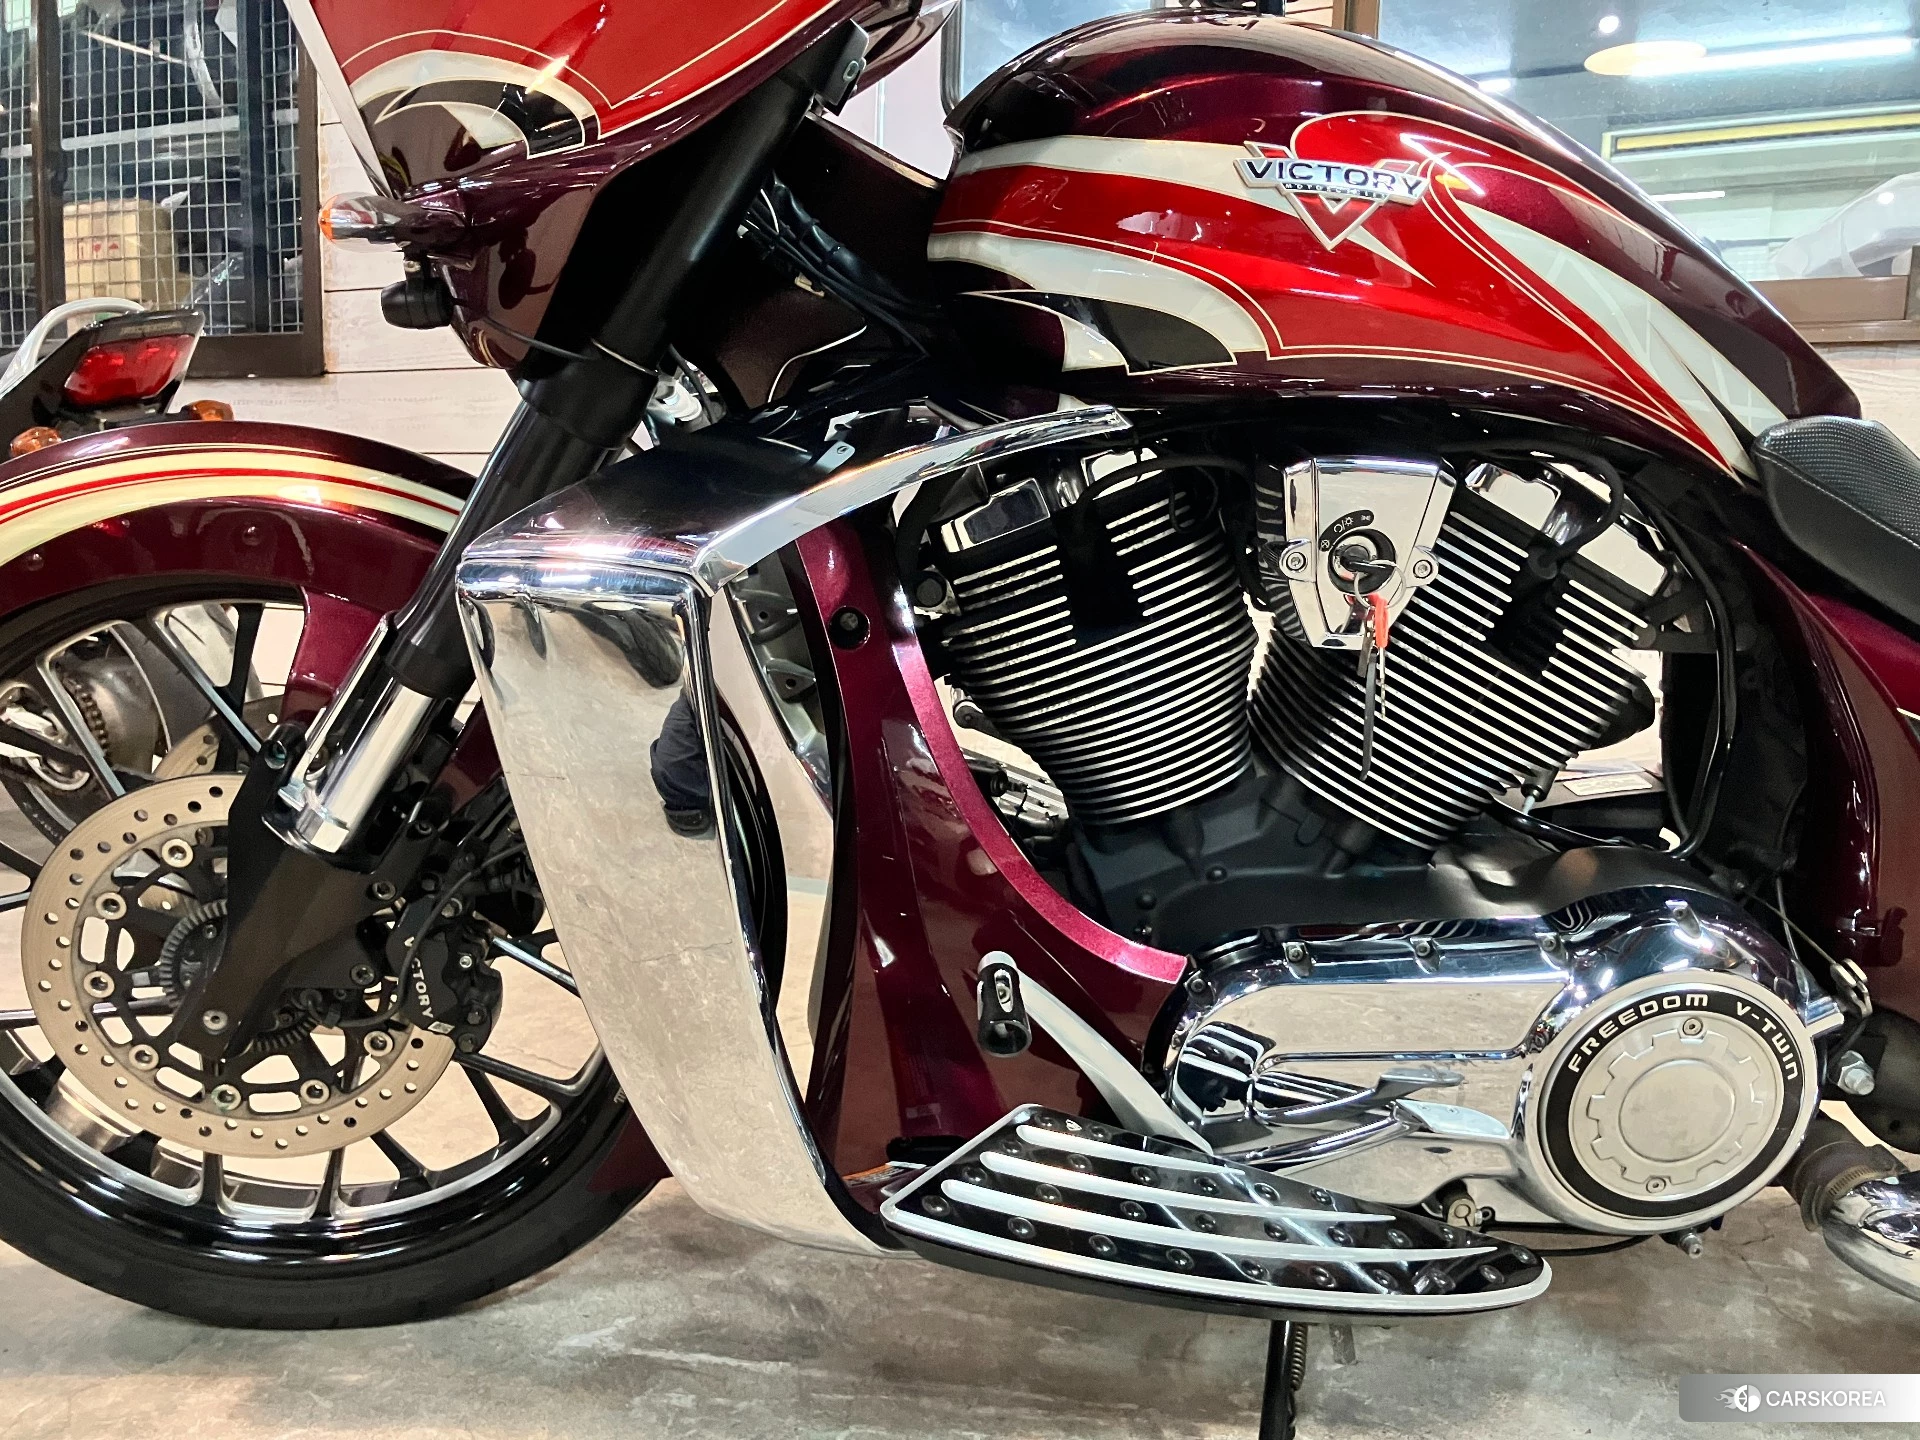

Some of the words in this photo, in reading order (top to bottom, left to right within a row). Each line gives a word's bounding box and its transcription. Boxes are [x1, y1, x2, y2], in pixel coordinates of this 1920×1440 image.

[1245, 160, 1423, 196] VICTORY
[404, 936, 434, 1018] VCTORY
[1567, 993, 1709, 1073] FREEDOM
[1735, 1001, 1799, 1081] V-TWIN
